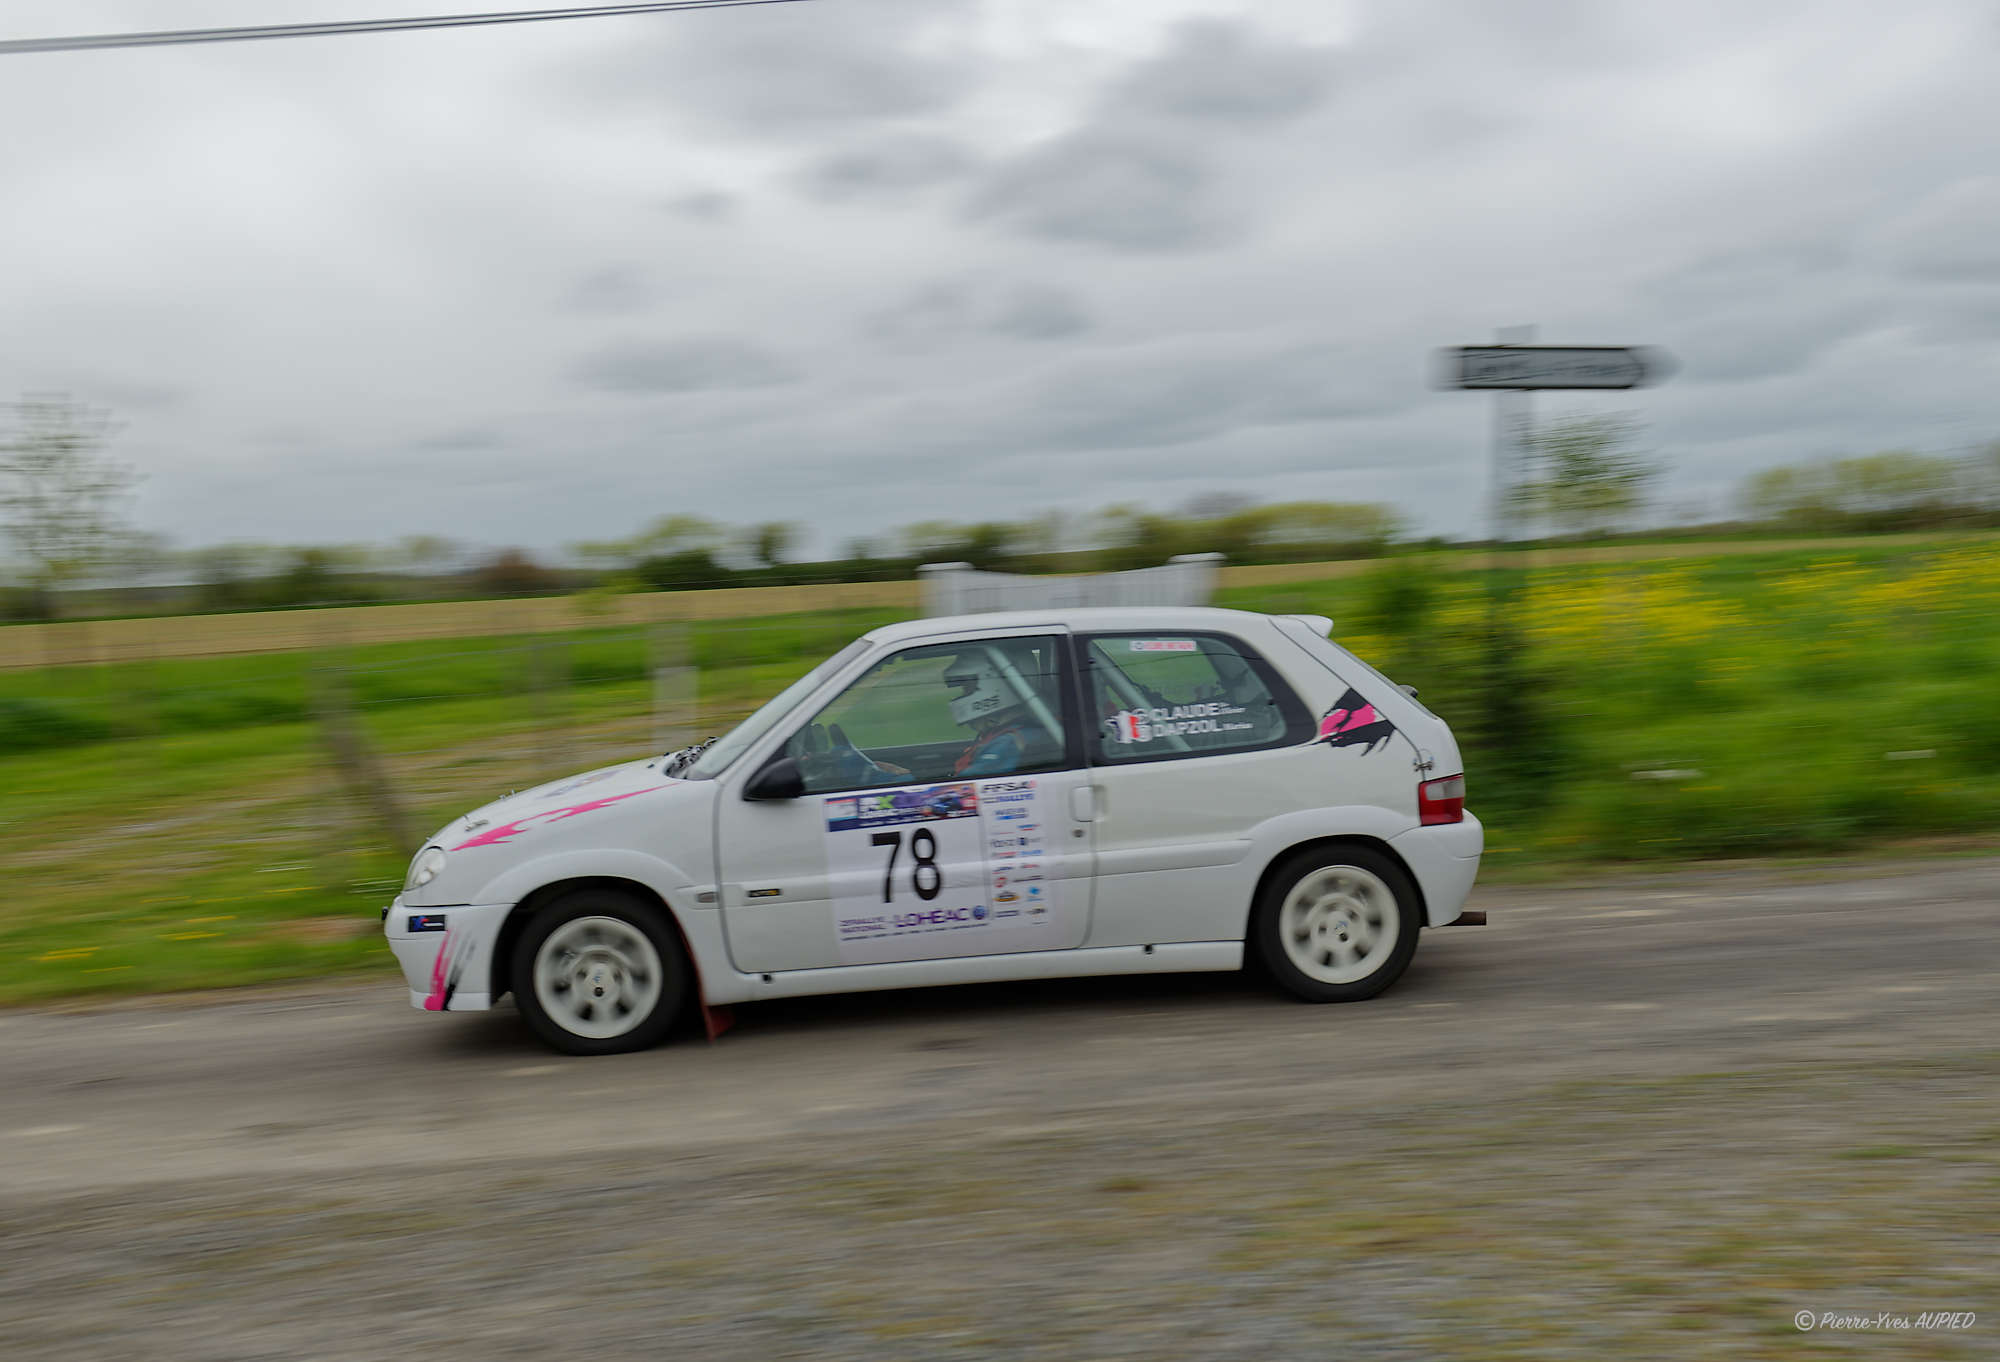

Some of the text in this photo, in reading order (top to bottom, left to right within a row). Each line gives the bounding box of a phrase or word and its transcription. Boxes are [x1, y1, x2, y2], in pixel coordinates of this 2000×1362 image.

[982, 781, 1032, 793] FFSA
[870, 827, 941, 903] 78
[895, 907, 969, 928] LOHEAC
